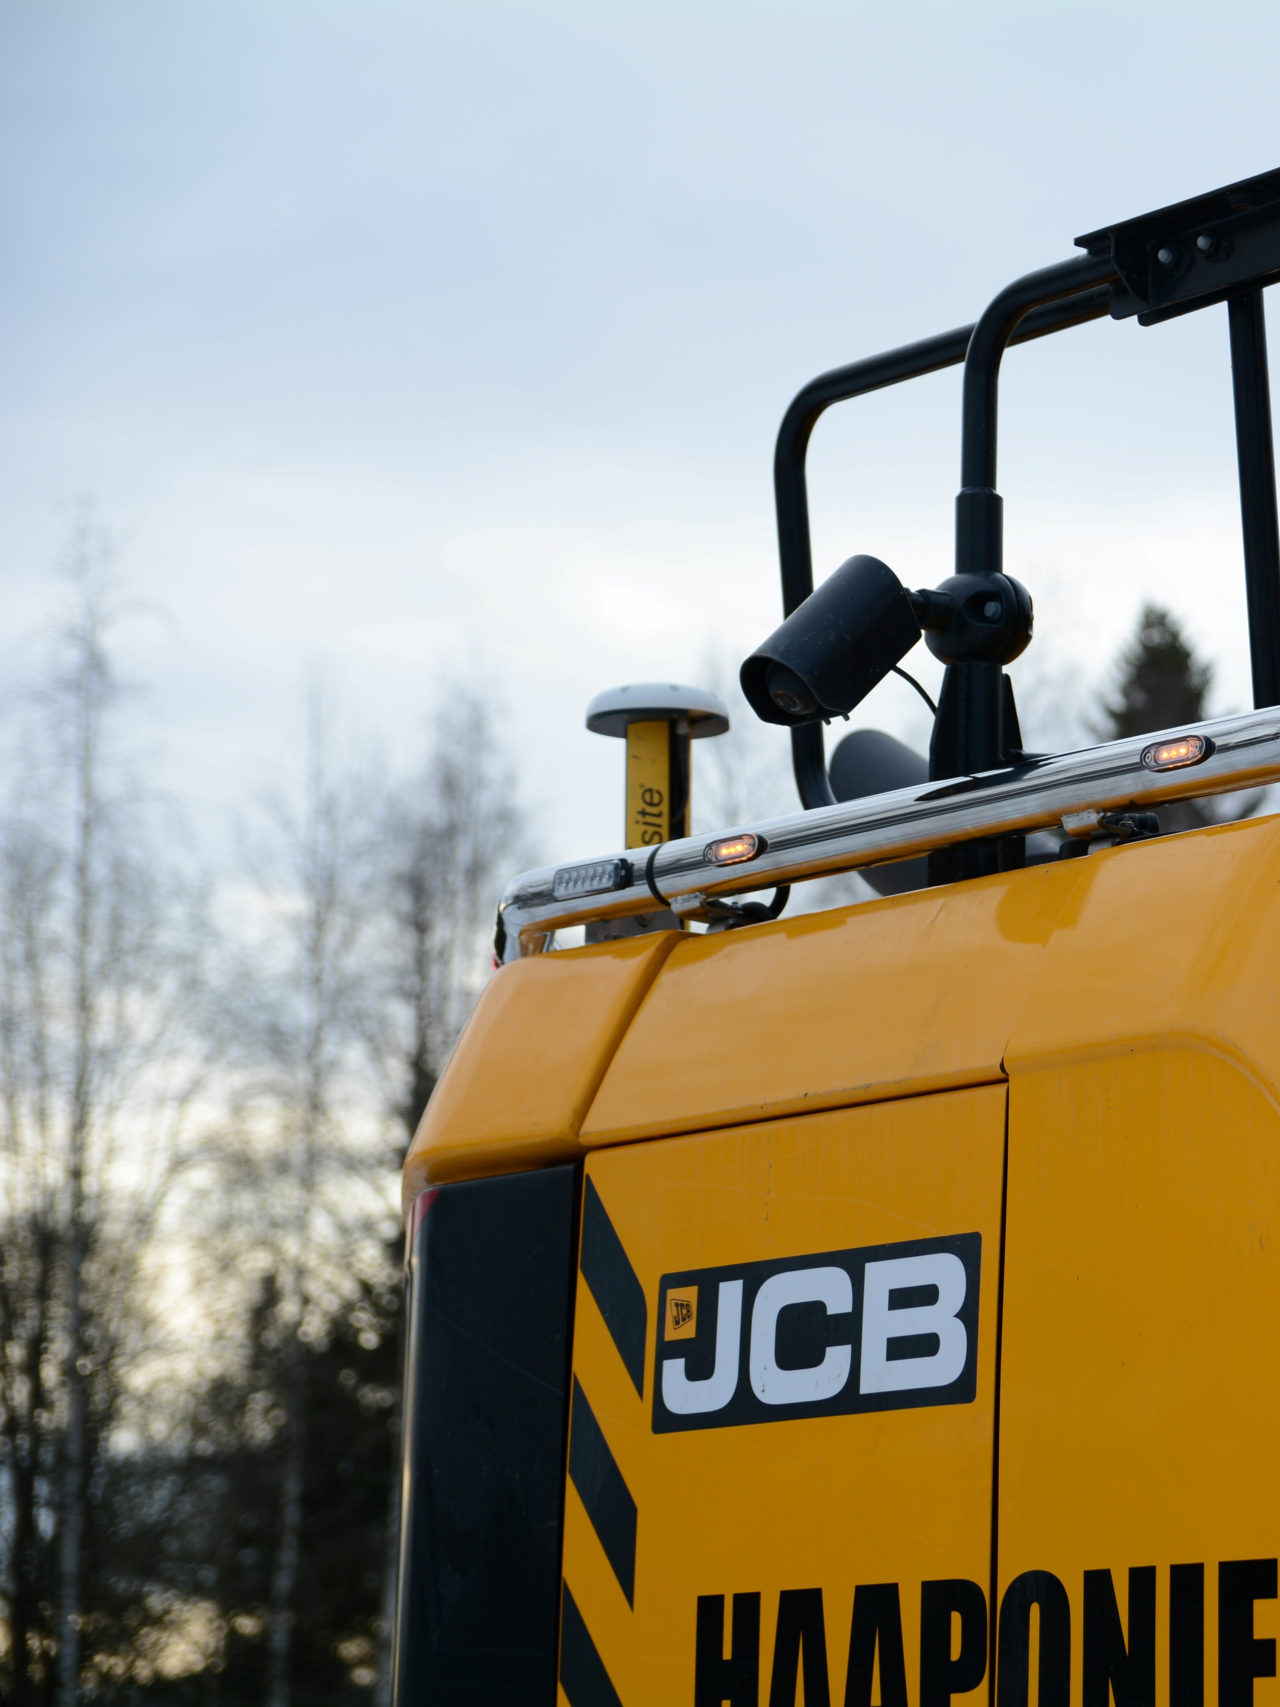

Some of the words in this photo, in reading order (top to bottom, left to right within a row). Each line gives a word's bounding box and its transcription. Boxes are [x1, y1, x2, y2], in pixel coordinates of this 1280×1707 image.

[634, 786, 664, 847] site
[661, 1252, 967, 1415] JCB
[674, 1301, 692, 1326] JCB
